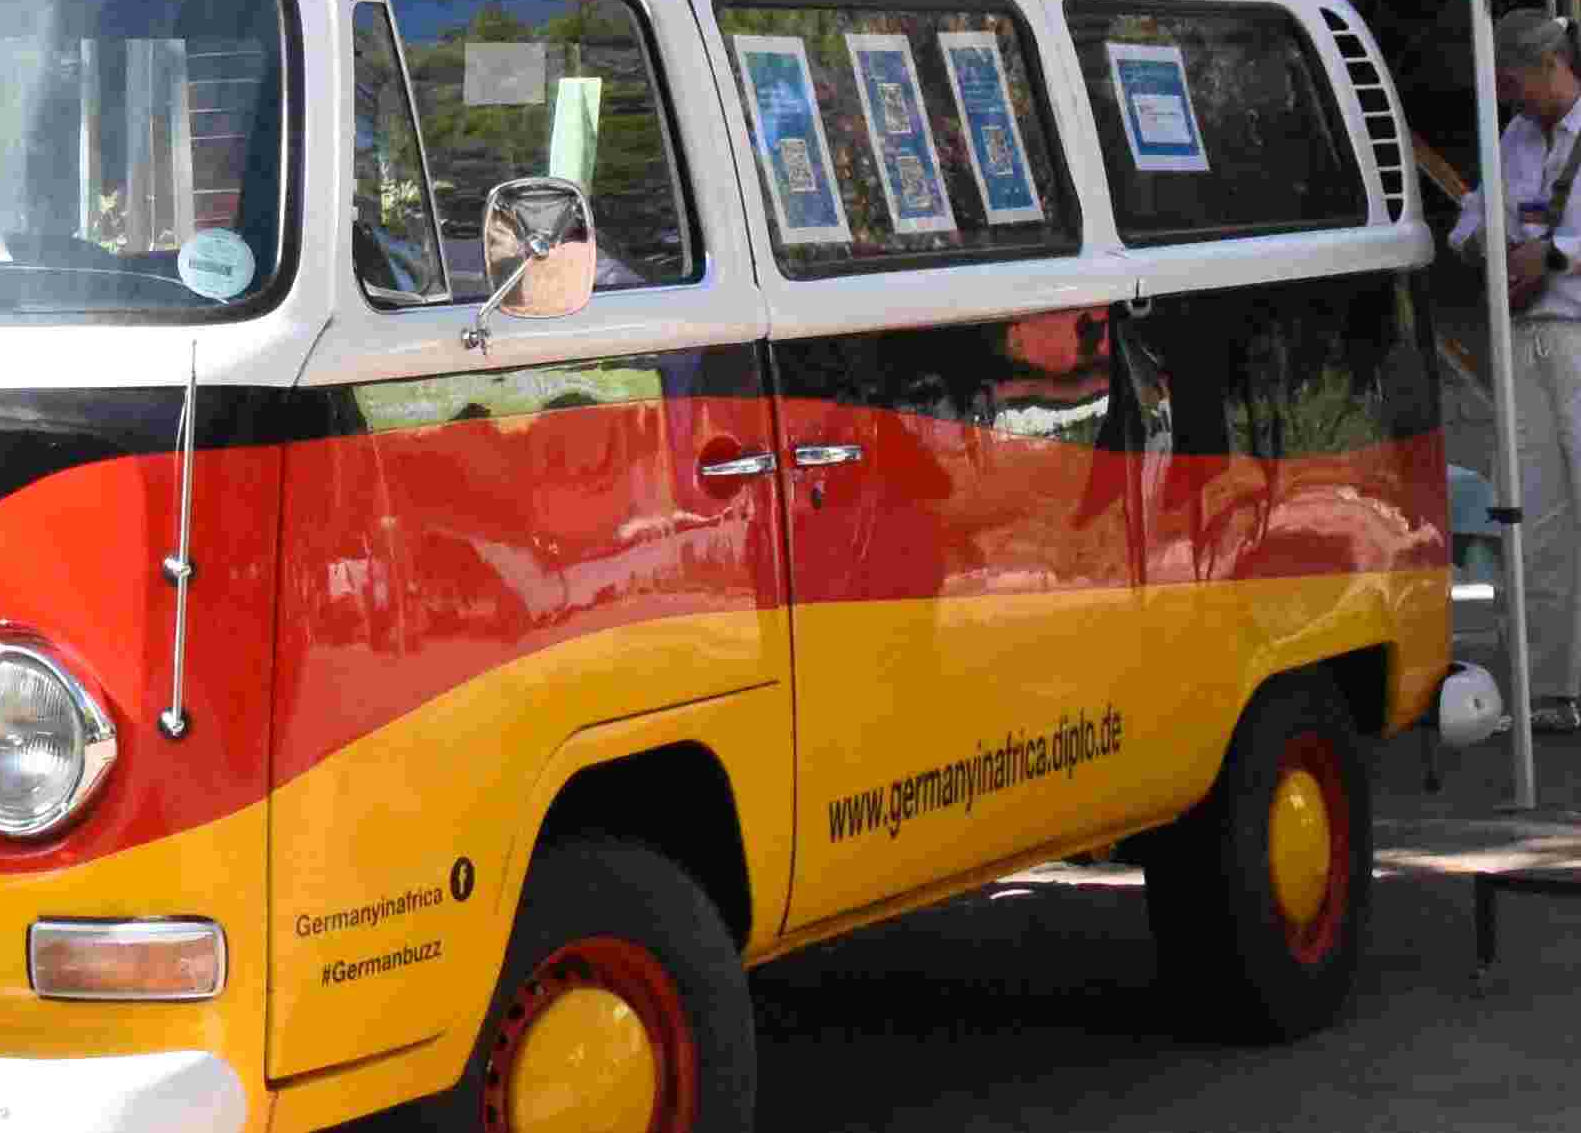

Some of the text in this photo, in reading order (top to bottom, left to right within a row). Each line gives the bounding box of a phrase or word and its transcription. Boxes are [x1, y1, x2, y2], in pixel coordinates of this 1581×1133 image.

[828, 700, 1123, 844] www.germanyinafrica.diplo.de
[295, 883, 444, 938] Germanyinafrica
[321, 939, 444, 988] #Germanbuzz
